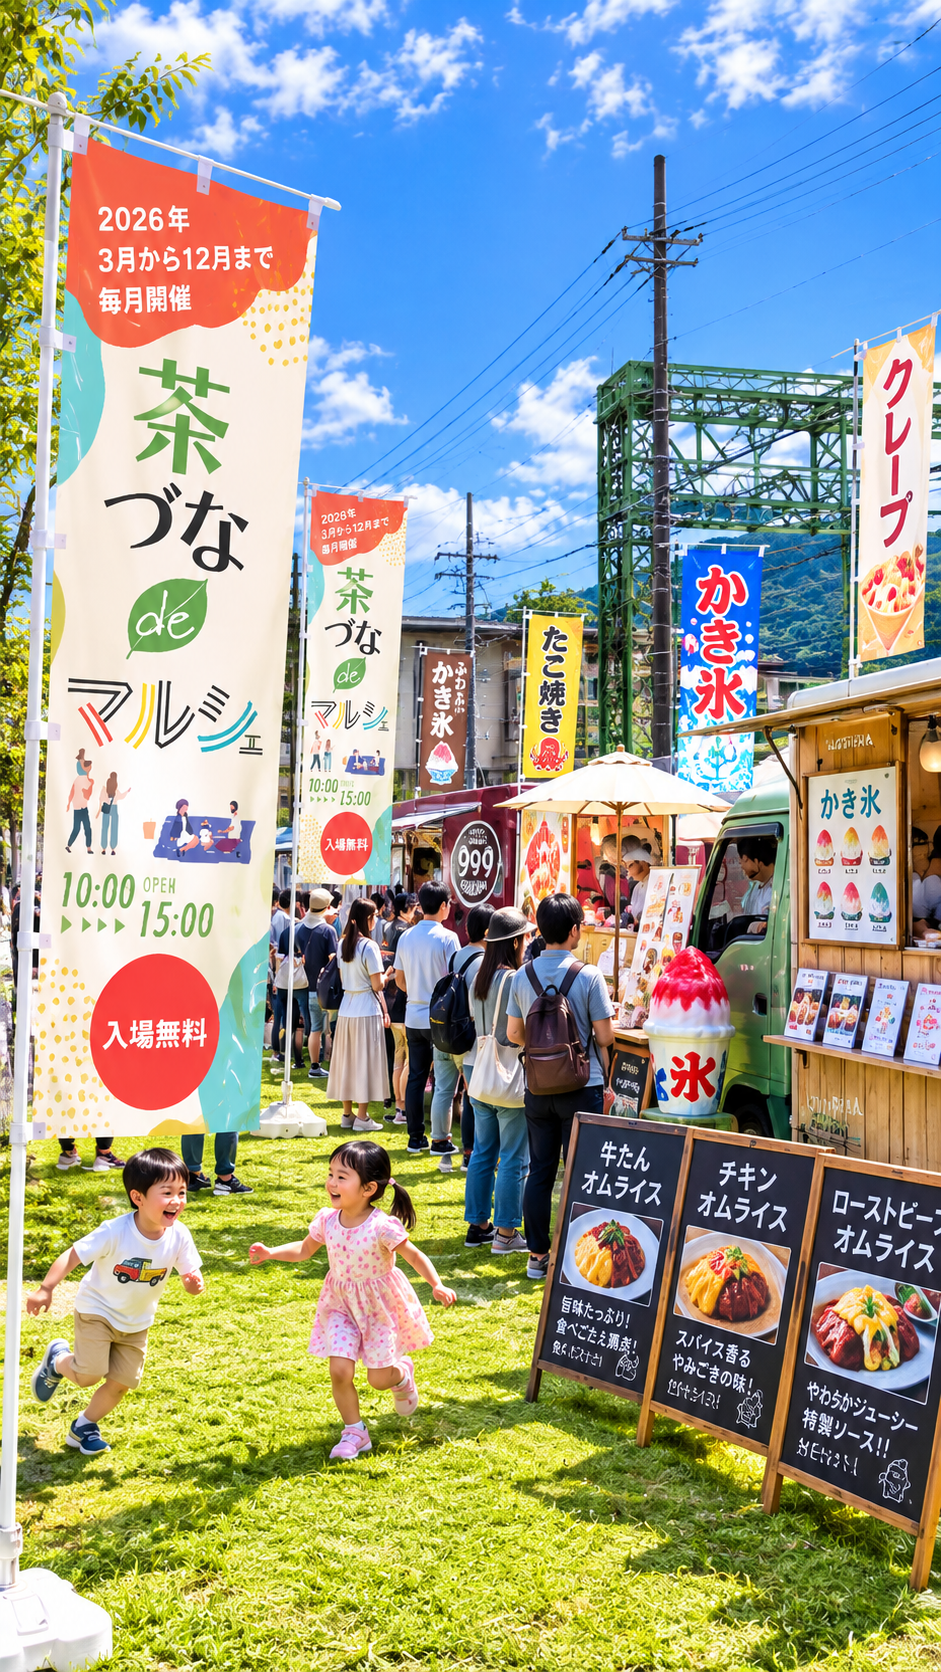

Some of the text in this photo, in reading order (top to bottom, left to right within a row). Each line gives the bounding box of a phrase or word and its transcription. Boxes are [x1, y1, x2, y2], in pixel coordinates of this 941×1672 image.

[98, 204, 190, 234] 2026年
[98, 245, 274, 273] 3月から12月まで
[99, 284, 192, 315] 毎月開催
[133, 358, 230, 475] 茶
[880, 358, 914, 548] クレープ
[104, 481, 249, 572] づな
[335, 566, 374, 615] 茶
[135, 588, 198, 642] de
[324, 618, 382, 656] づな
[694, 565, 748, 720] かき氷
[336, 663, 361, 685] de
[538, 625, 569, 734] たこ焼き
[68, 678, 263, 756] マルシェ
[311, 700, 390, 732] マルシェ
[430, 660, 454, 739] かき氷
[308, 778, 339, 794] 10:00
[340, 790, 371, 806] 15:00
[820, 784, 882, 820] かき氷
[457, 845, 494, 879] 999
[62, 871, 136, 909] 10:00
[140, 900, 214, 938] 15:00
[102, 1017, 207, 1051] 入場無料
[669, 1051, 716, 1103] 氷
[600, 1140, 651, 1173] 牛たん
[581, 1170, 662, 1206] オムライス
[718, 1160, 778, 1193] チキン
[697, 1190, 788, 1232] オムライス
[833, 1224, 935, 1273] オムライス
